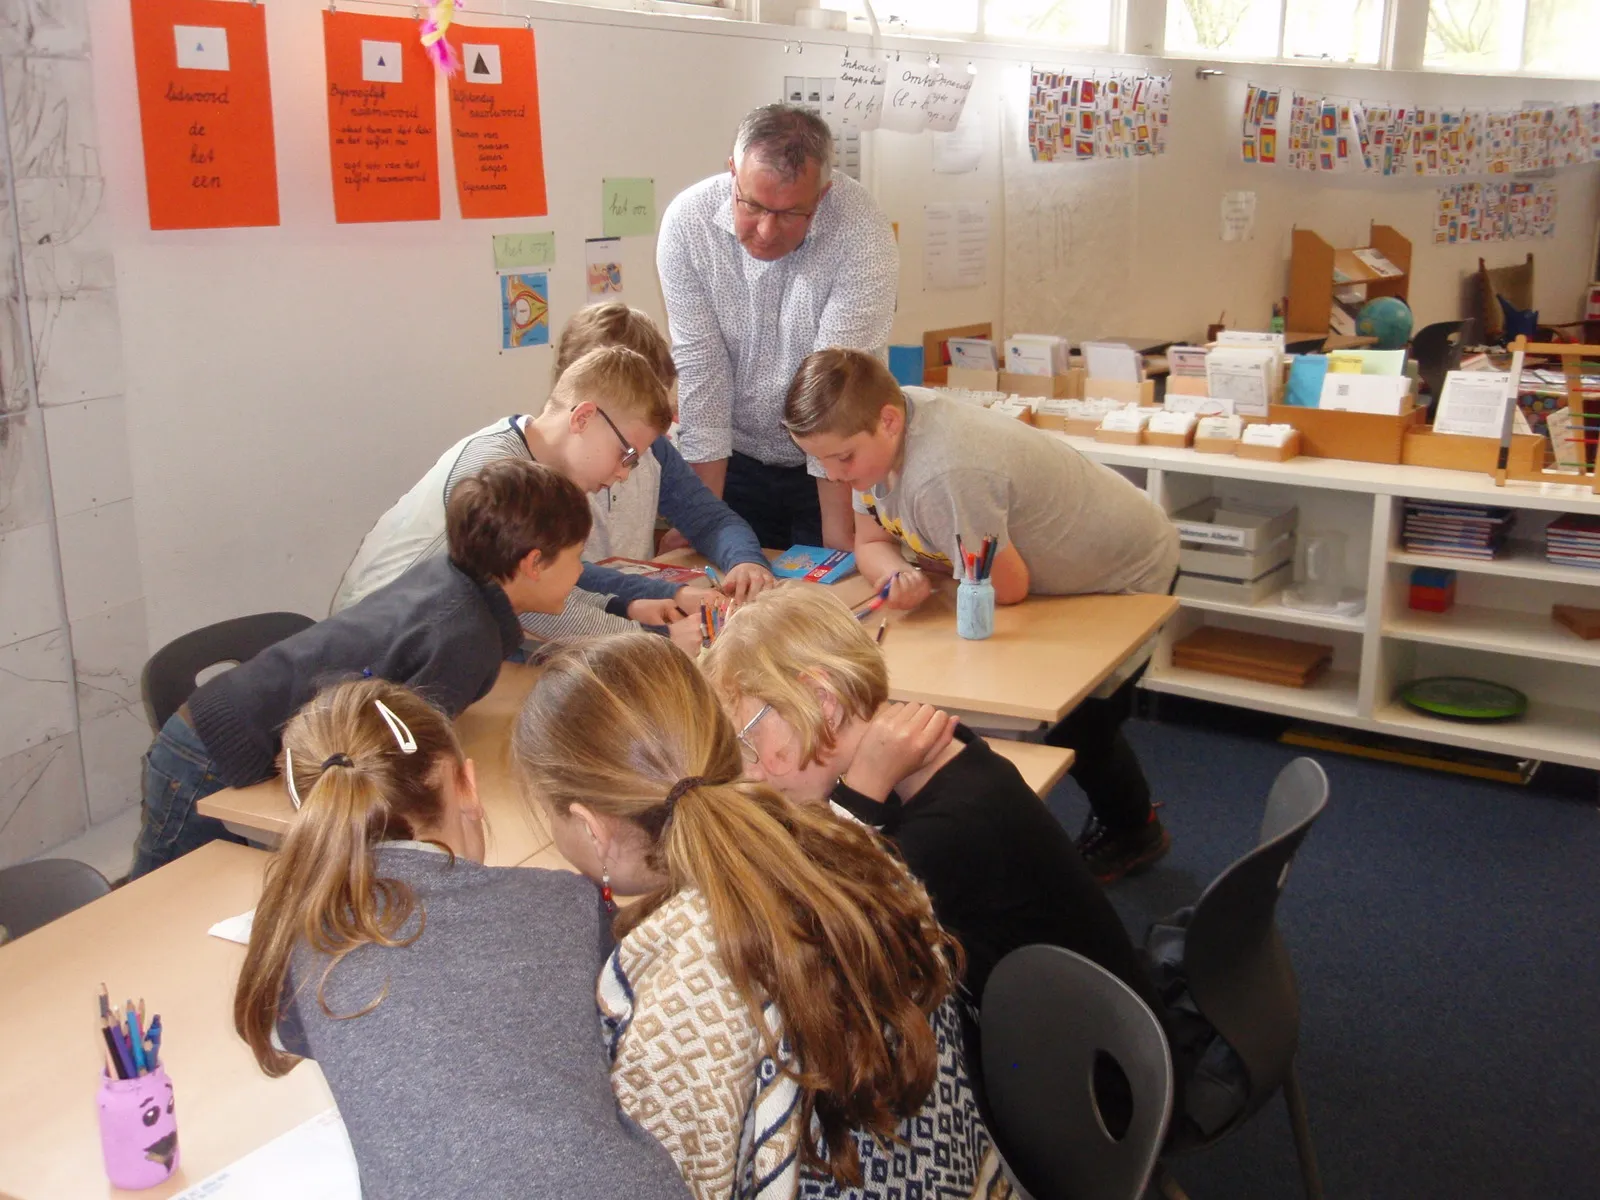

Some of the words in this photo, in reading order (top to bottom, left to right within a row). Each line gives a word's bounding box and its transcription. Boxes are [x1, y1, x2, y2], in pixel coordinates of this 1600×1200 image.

[189, 120, 206, 136] de
[190, 143, 214, 164] het
[191, 175, 220, 188] een
